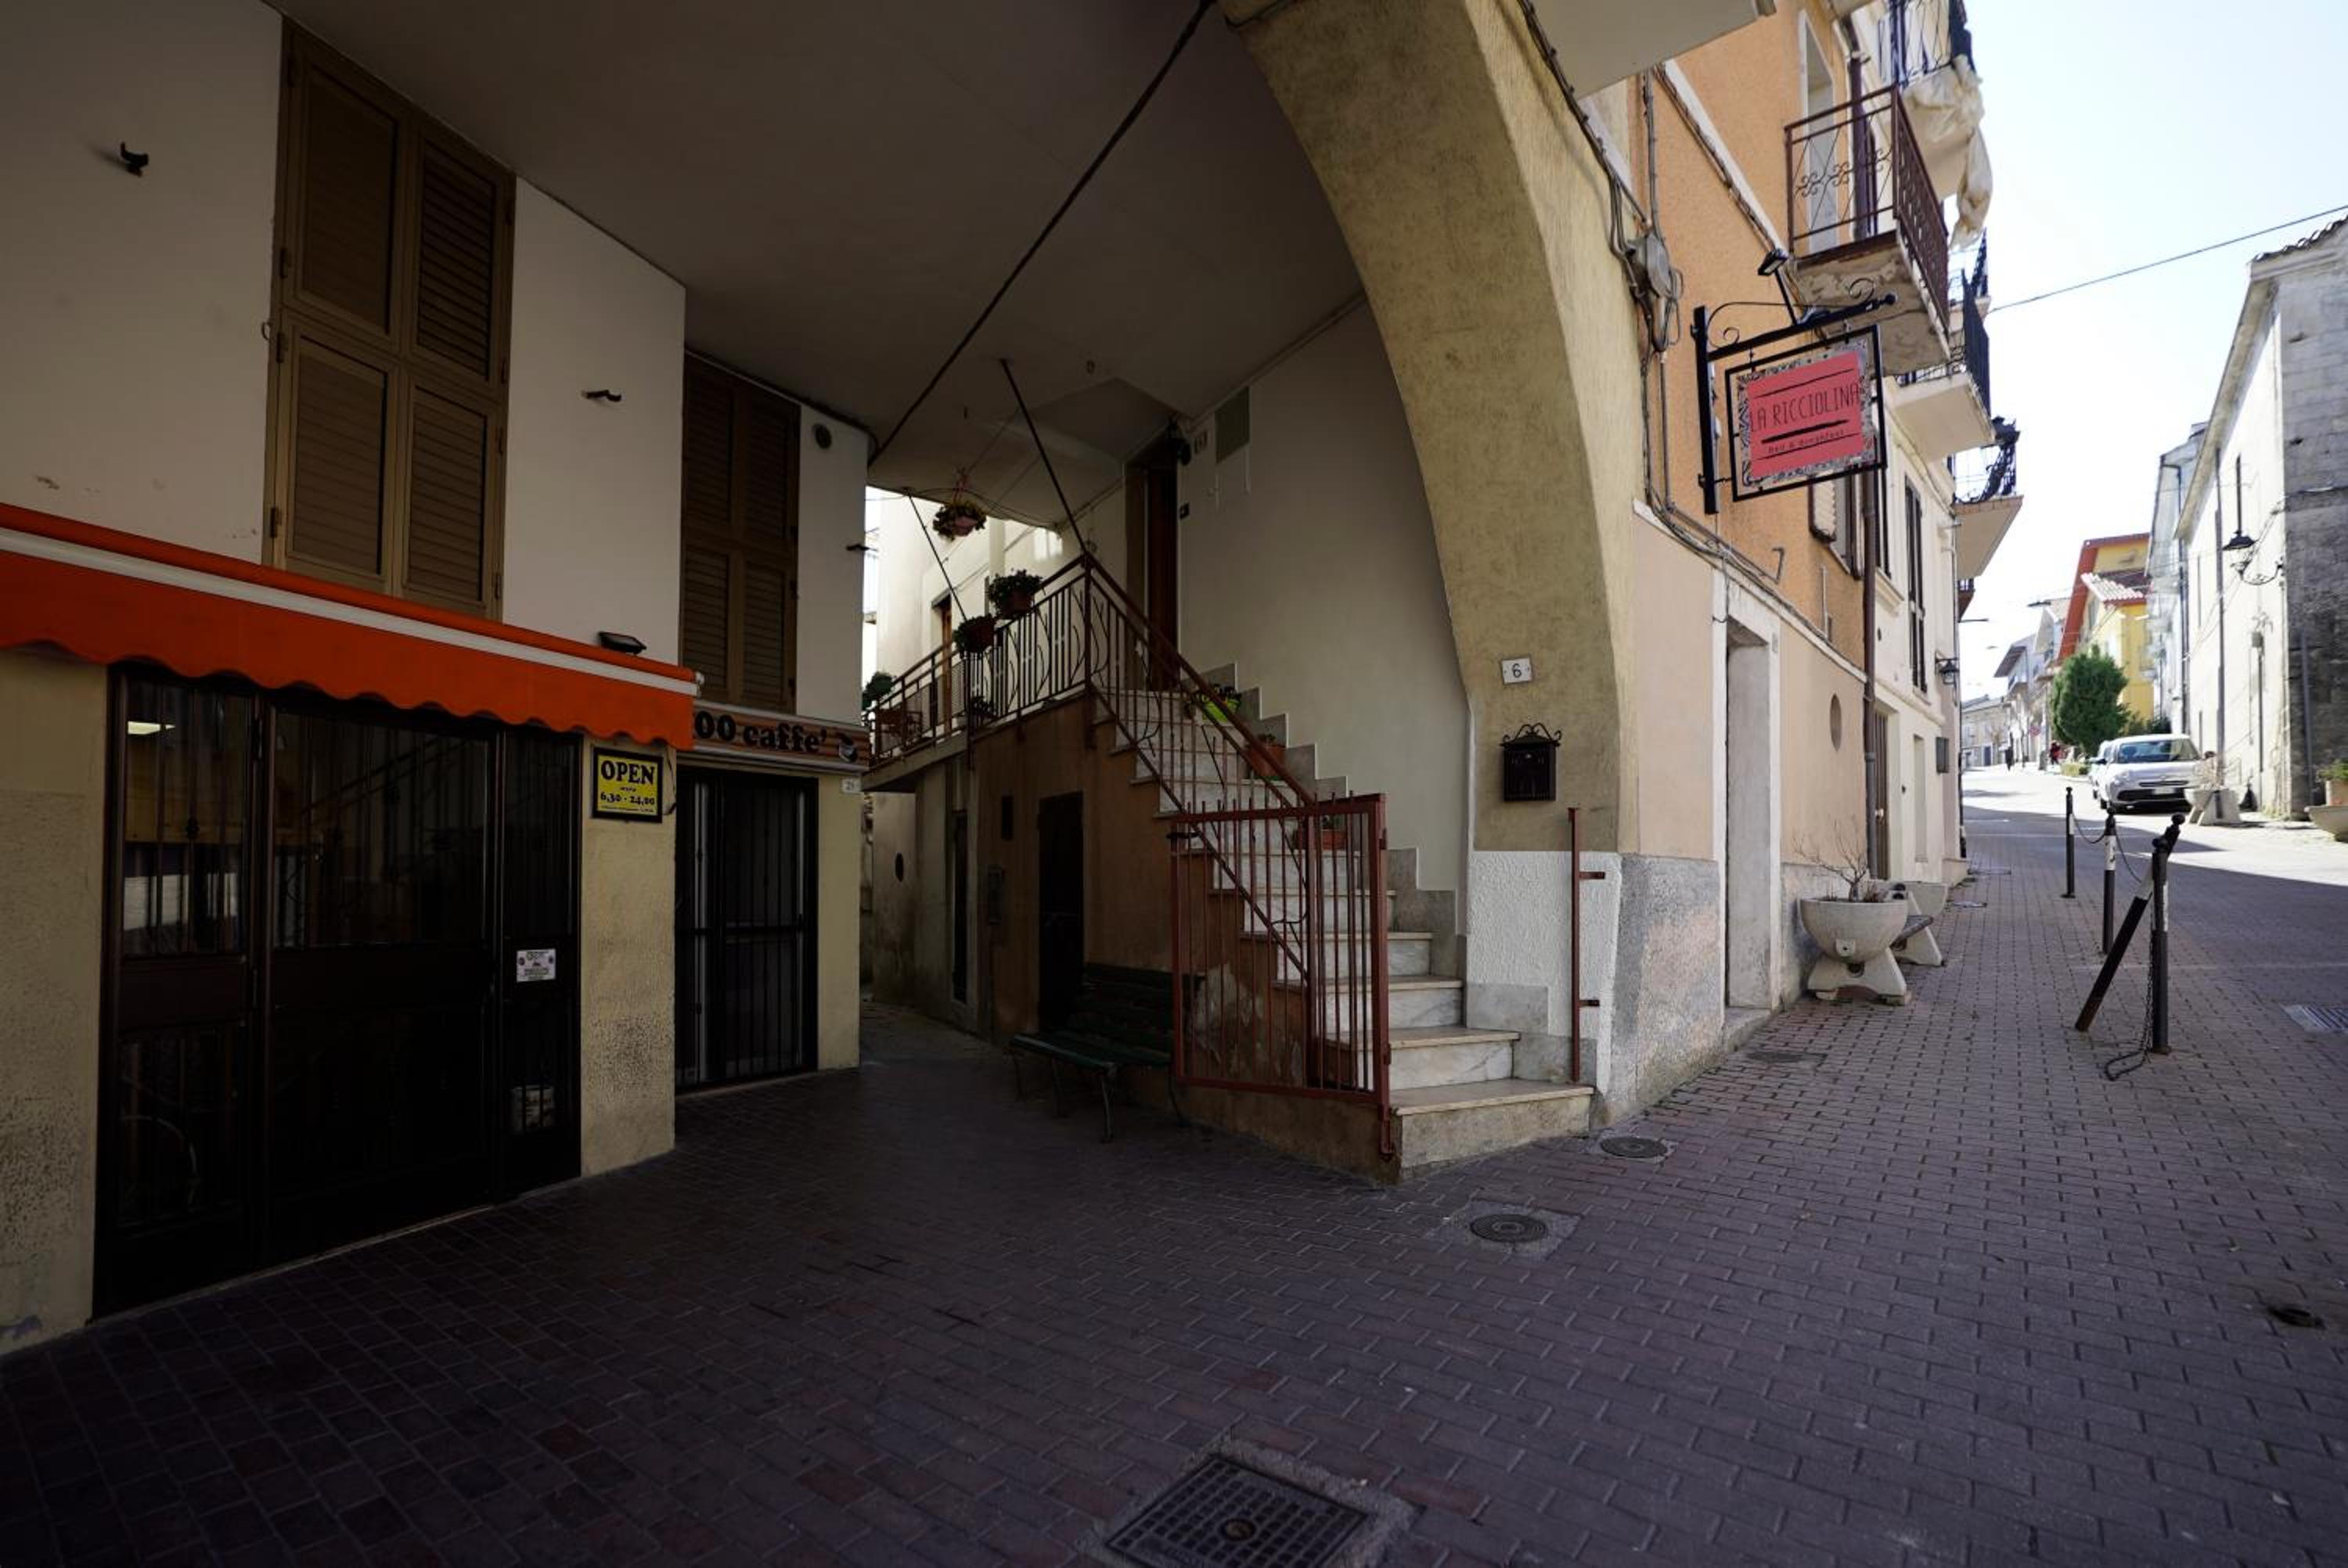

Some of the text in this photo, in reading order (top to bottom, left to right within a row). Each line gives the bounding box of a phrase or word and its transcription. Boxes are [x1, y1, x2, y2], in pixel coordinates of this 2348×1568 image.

[1749, 381, 1860, 433] LA RICCIOLINA
[1511, 663, 1522, 678] 6
[601, 760, 655, 785] OPEN
